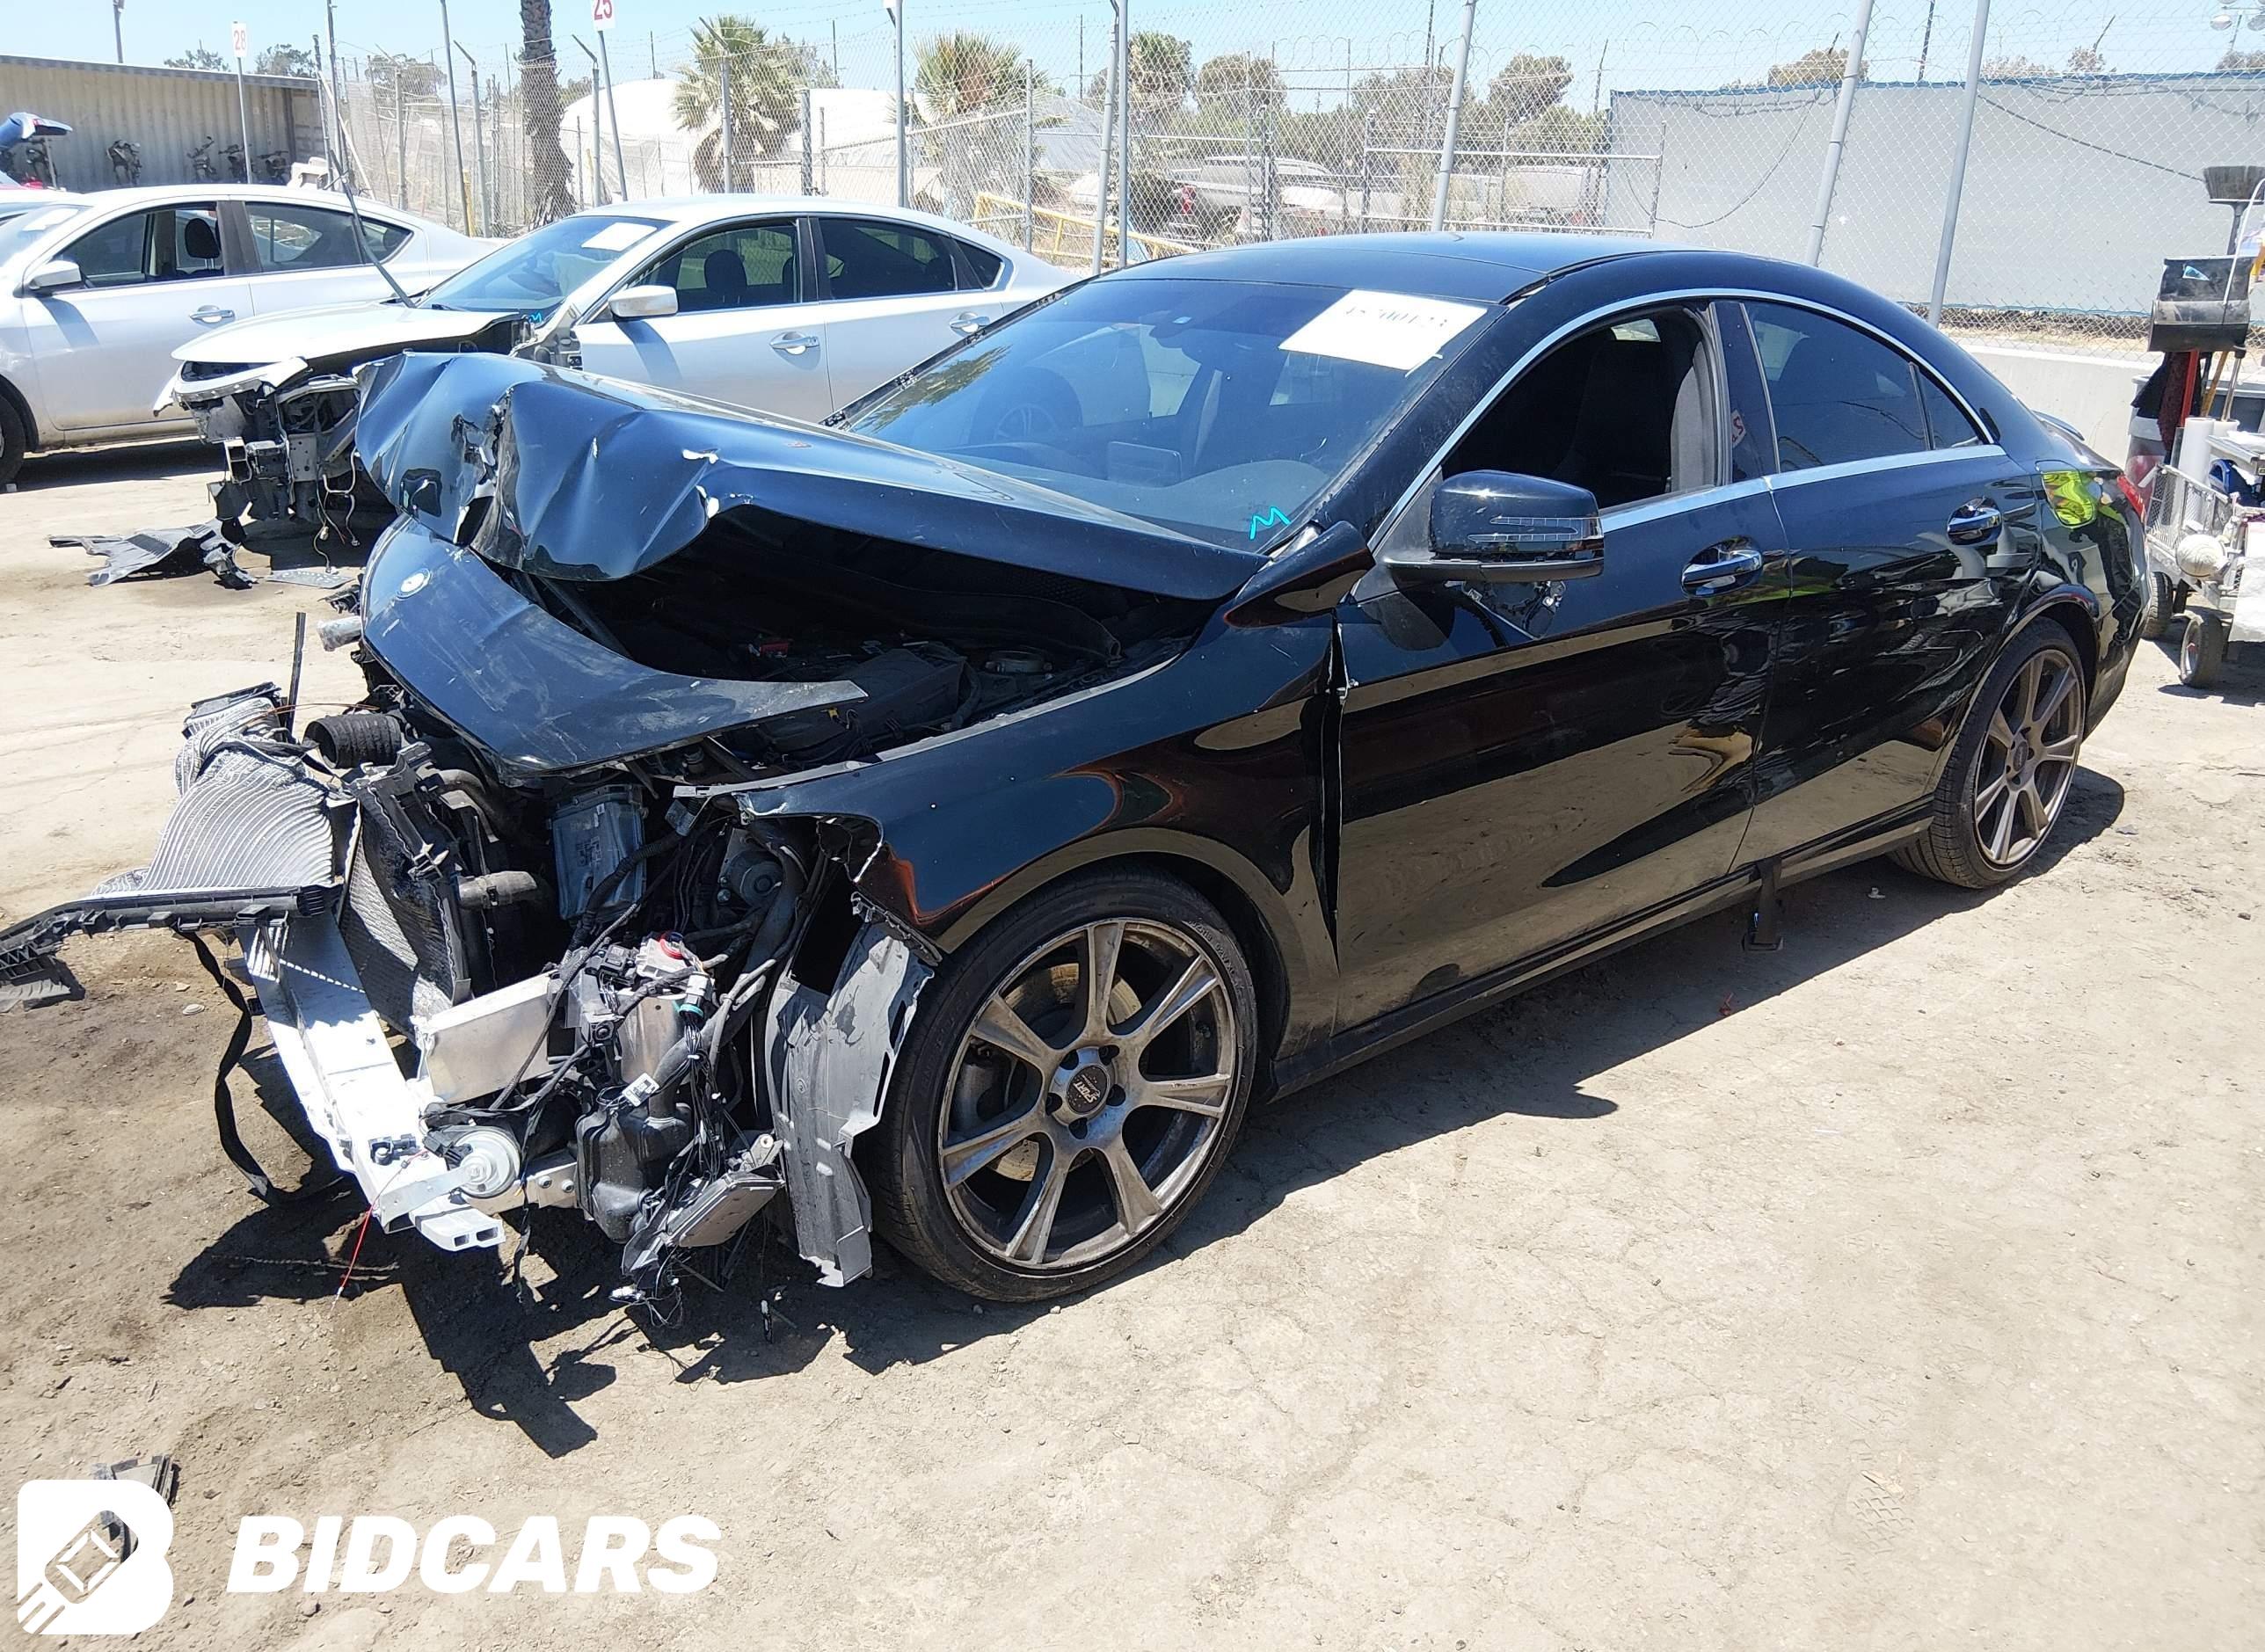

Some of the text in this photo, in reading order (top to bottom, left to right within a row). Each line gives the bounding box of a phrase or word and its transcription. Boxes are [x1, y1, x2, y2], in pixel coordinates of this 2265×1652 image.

[594, 0, 613, 20] 25
[233, 29, 246, 50] 28
[1249, 506, 1291, 541] M
[1073, 1081, 1098, 1103] SPORT
